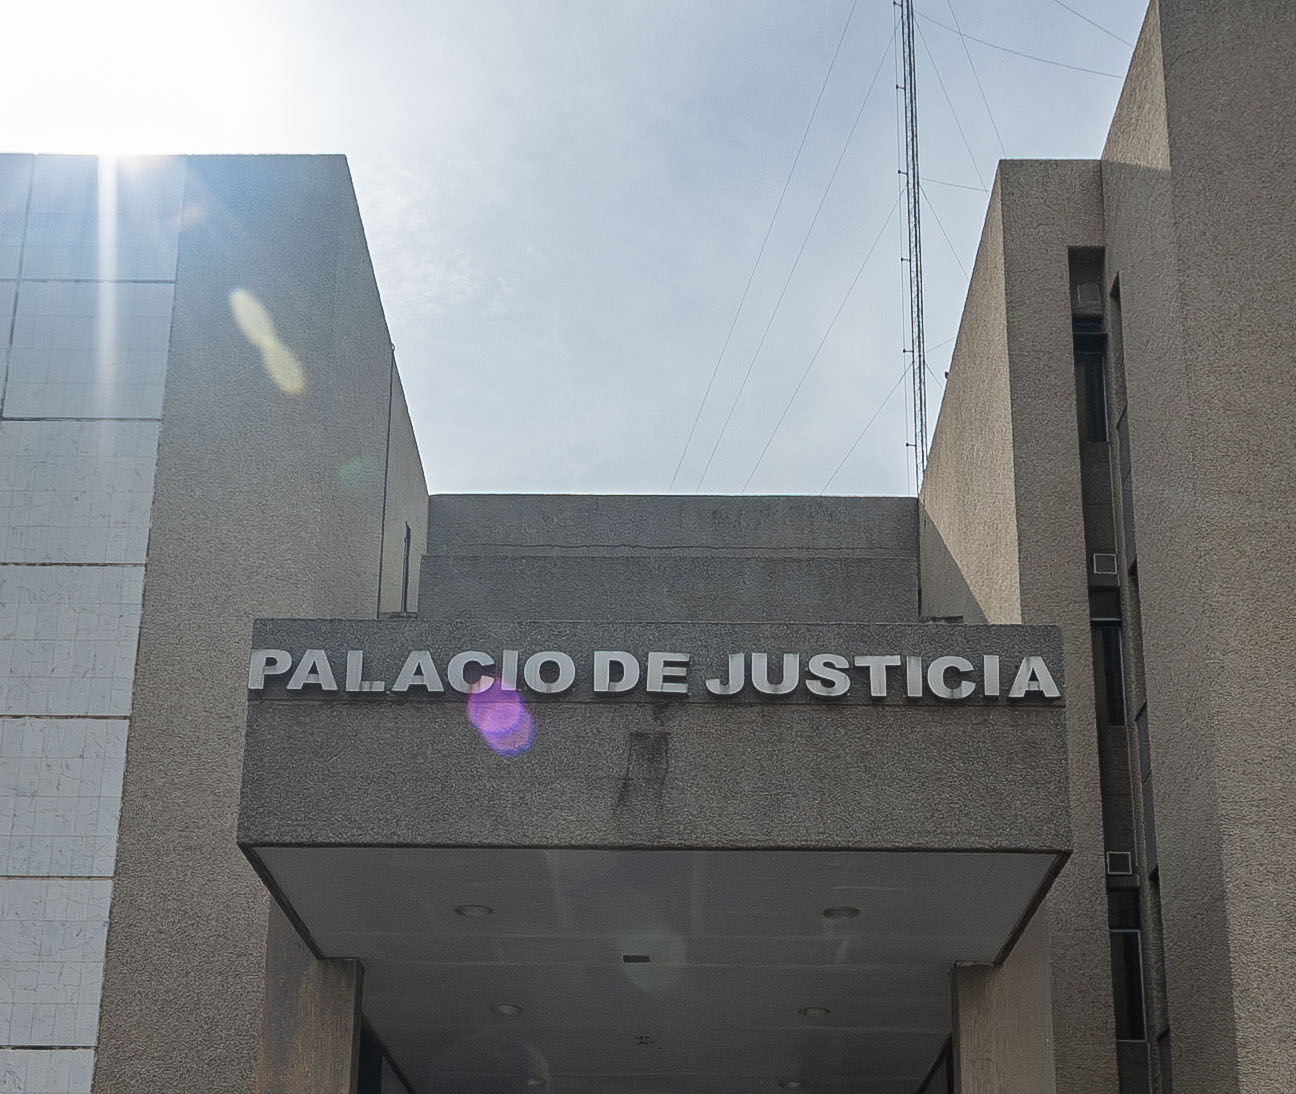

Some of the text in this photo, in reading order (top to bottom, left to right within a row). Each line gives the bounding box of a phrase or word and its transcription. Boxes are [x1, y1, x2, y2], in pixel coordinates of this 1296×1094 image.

[247, 649, 1061, 698] PALACIO DE JUSTICIA
